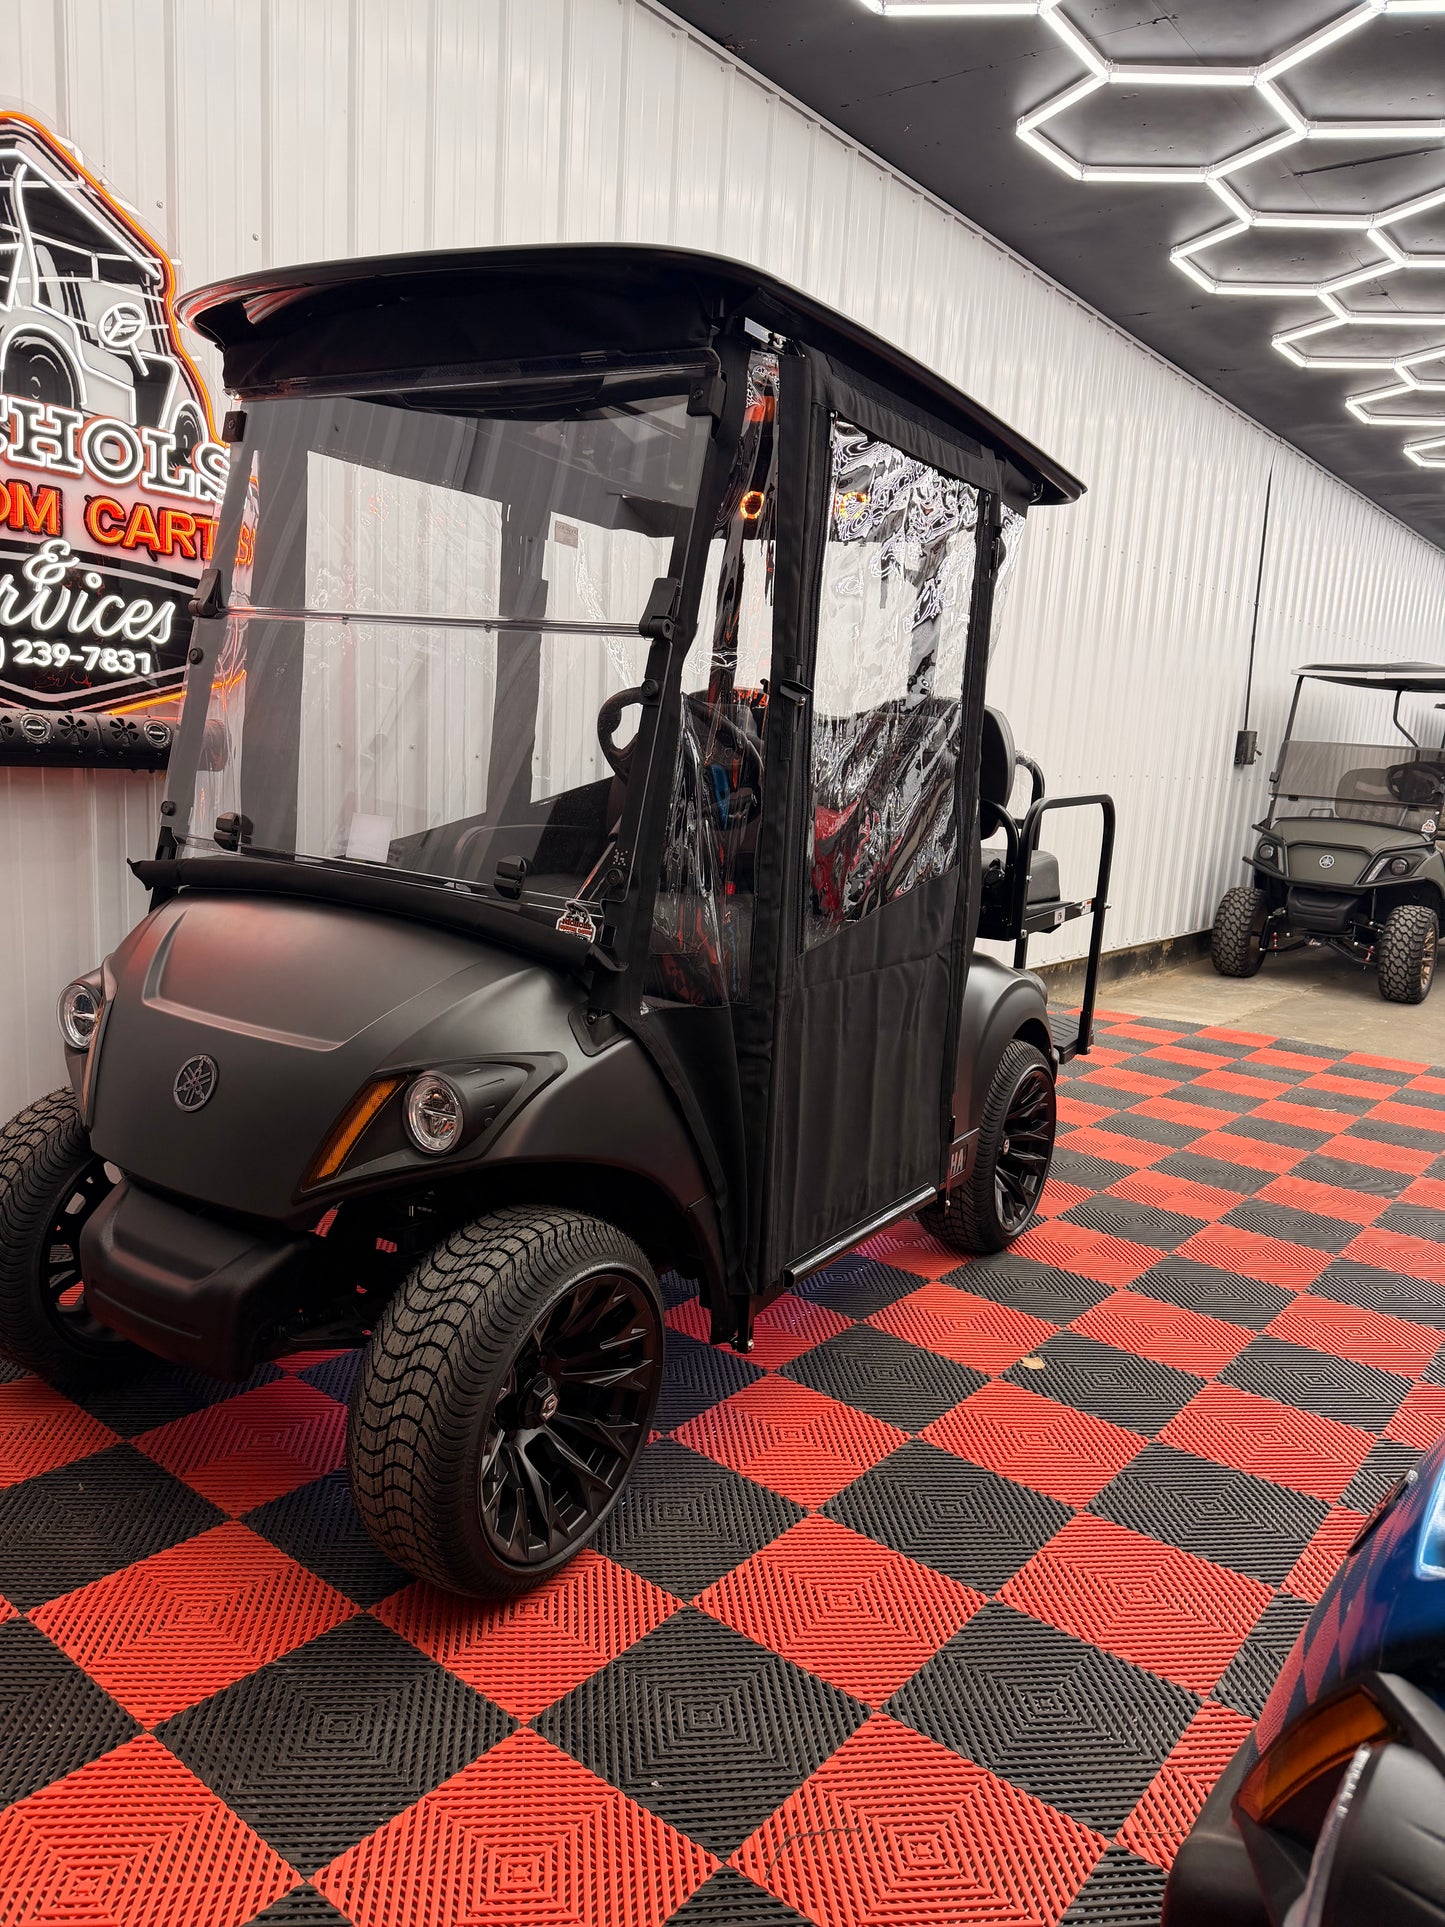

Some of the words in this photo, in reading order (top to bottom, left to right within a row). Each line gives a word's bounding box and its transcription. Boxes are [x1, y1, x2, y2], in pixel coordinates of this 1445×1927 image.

[0, 394, 231, 504] HOLS
[22, 539, 80, 592] &
[12, 638, 151, 675] 239-7831
